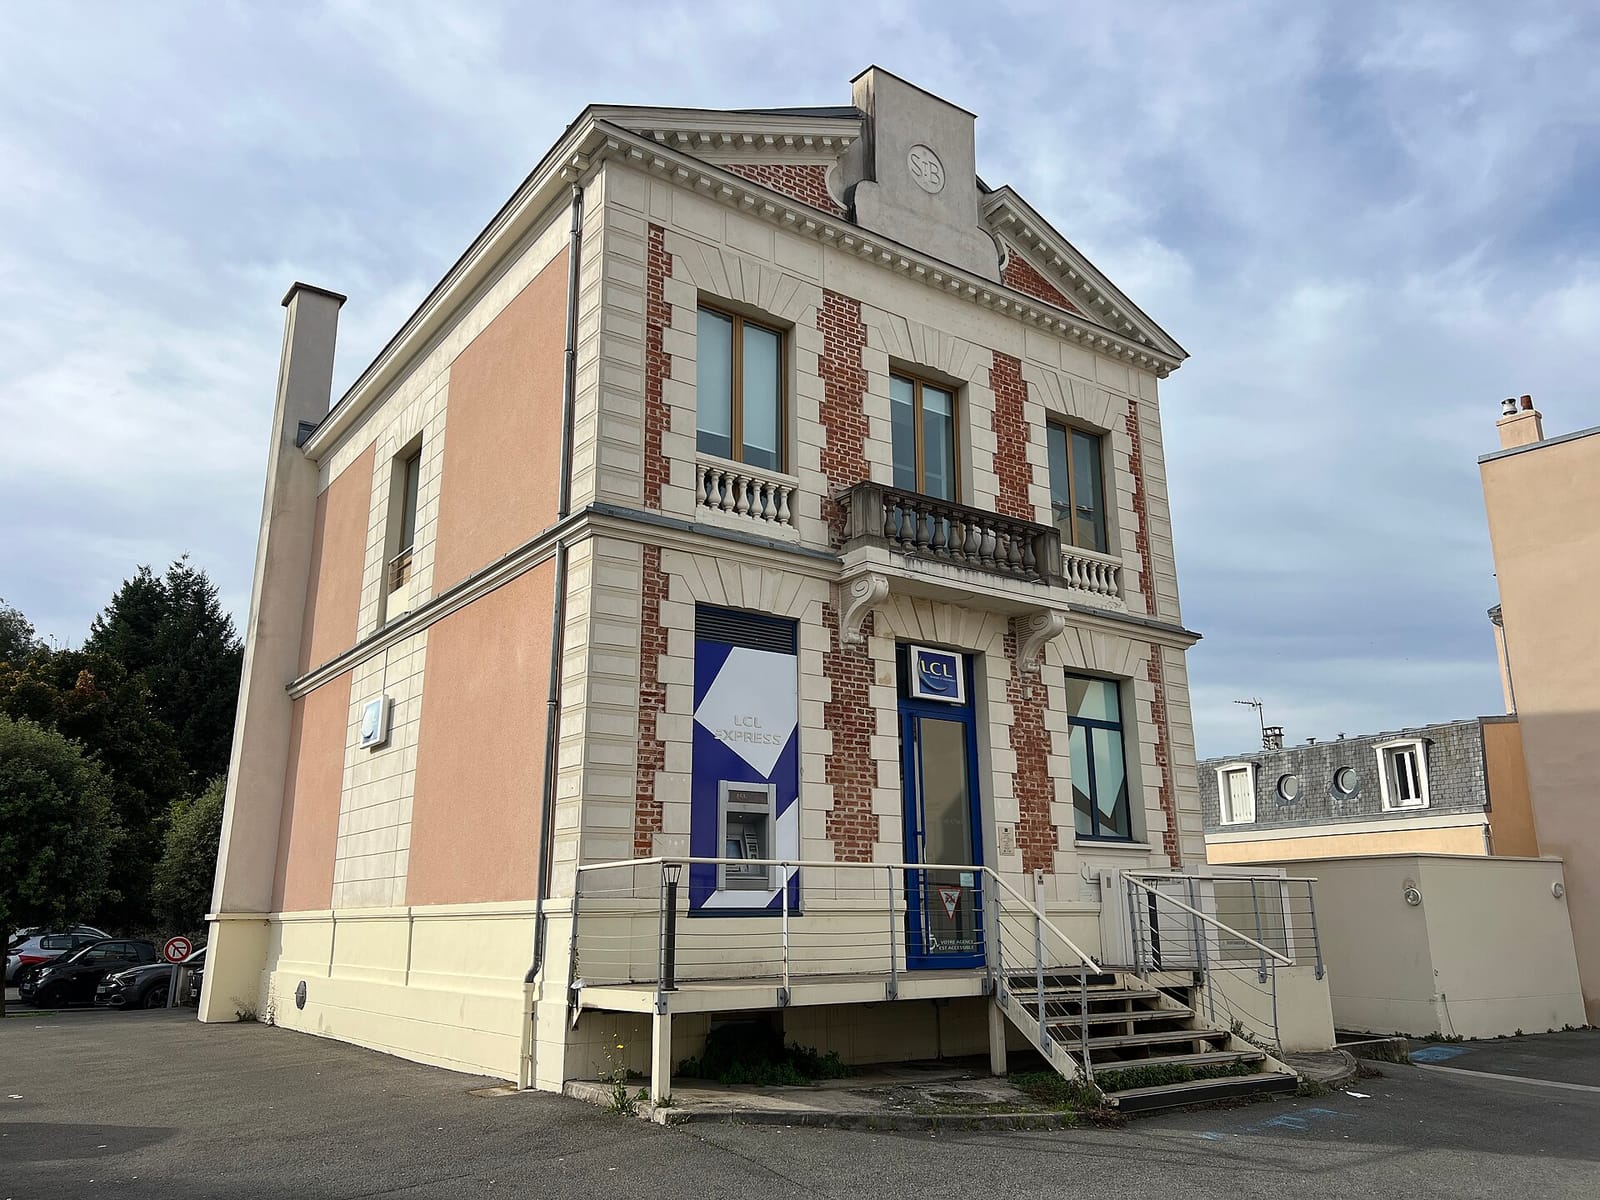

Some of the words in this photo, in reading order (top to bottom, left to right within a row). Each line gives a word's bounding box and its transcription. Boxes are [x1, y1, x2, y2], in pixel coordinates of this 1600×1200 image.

[920, 660, 953, 678] LCL
[734, 714, 762, 729] LCL
[714, 729, 782, 746] EXPRESS
